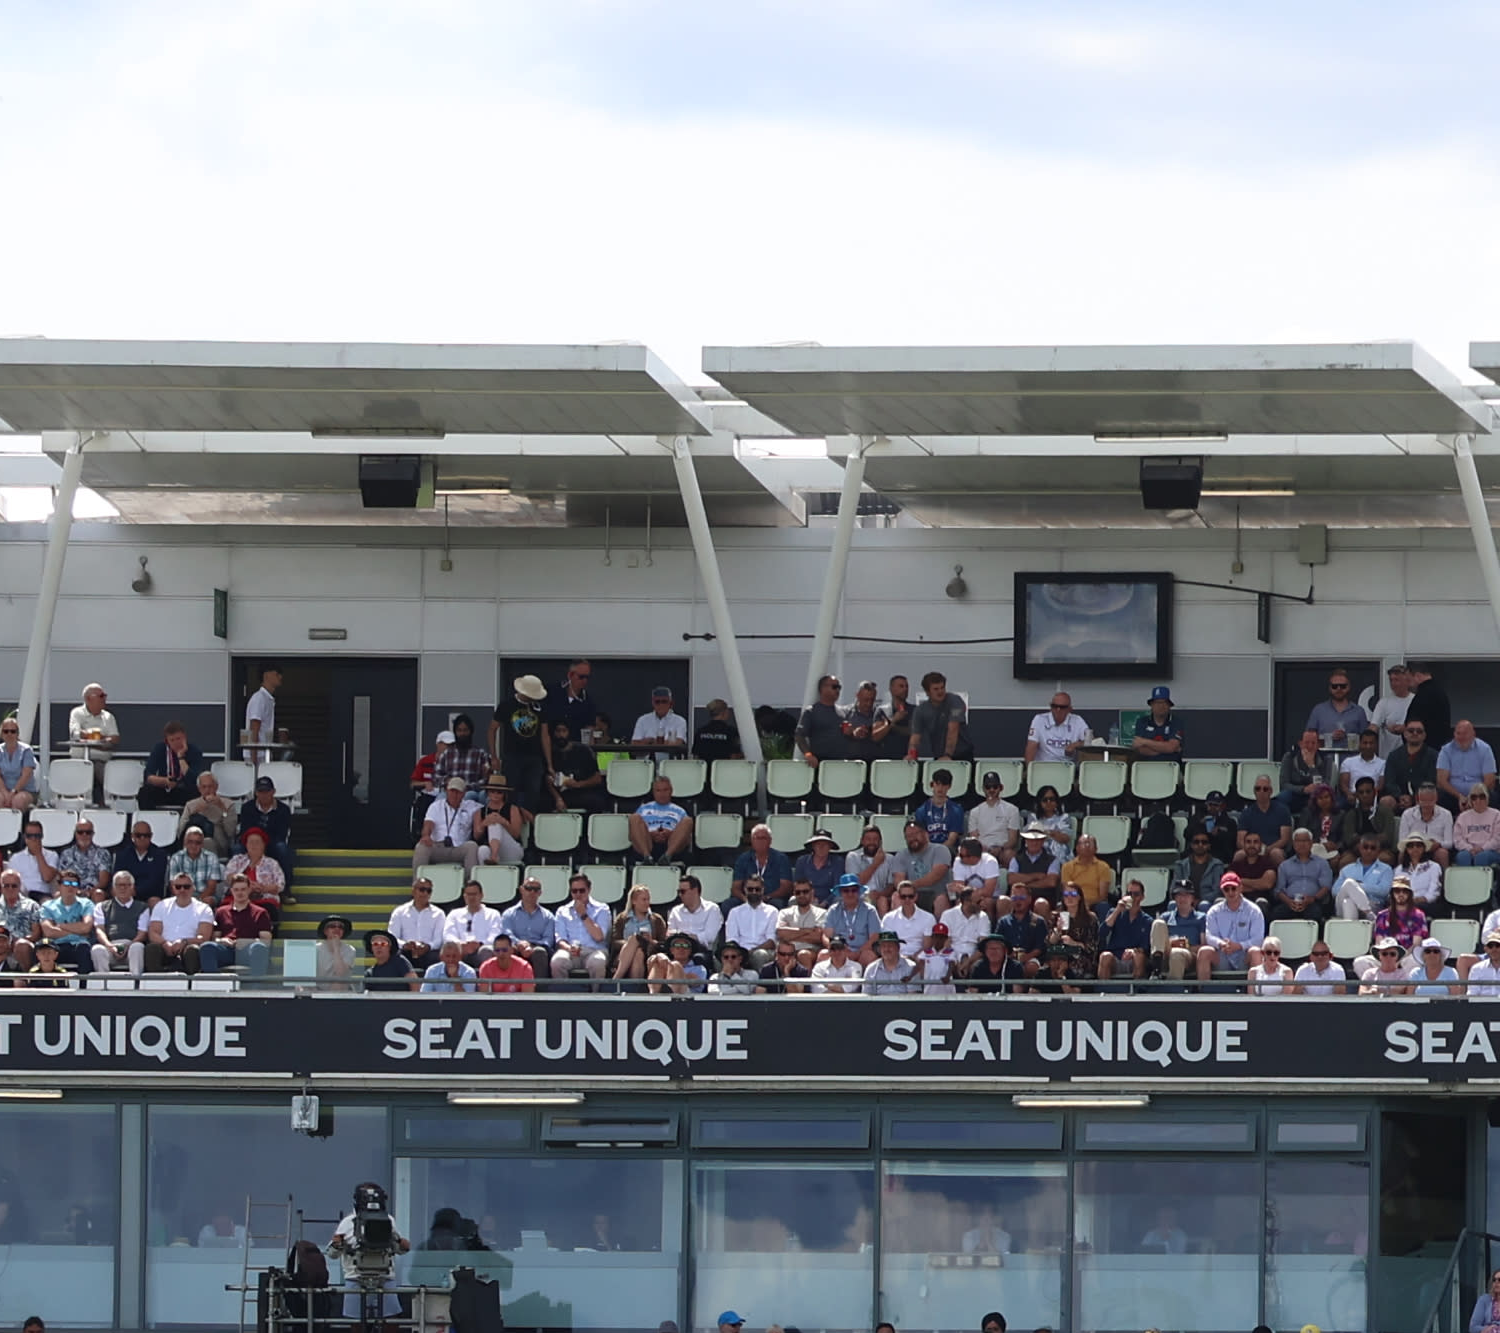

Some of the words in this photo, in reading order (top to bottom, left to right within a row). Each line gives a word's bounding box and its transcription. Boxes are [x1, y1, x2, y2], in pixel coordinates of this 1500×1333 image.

[35, 1015, 246, 1062] UNIQUE
[383, 1019, 523, 1058] SEAT
[536, 1020, 747, 1065] UNIQUE
[884, 1020, 1023, 1060] SEAT
[1037, 1021, 1247, 1067] UNIQUE
